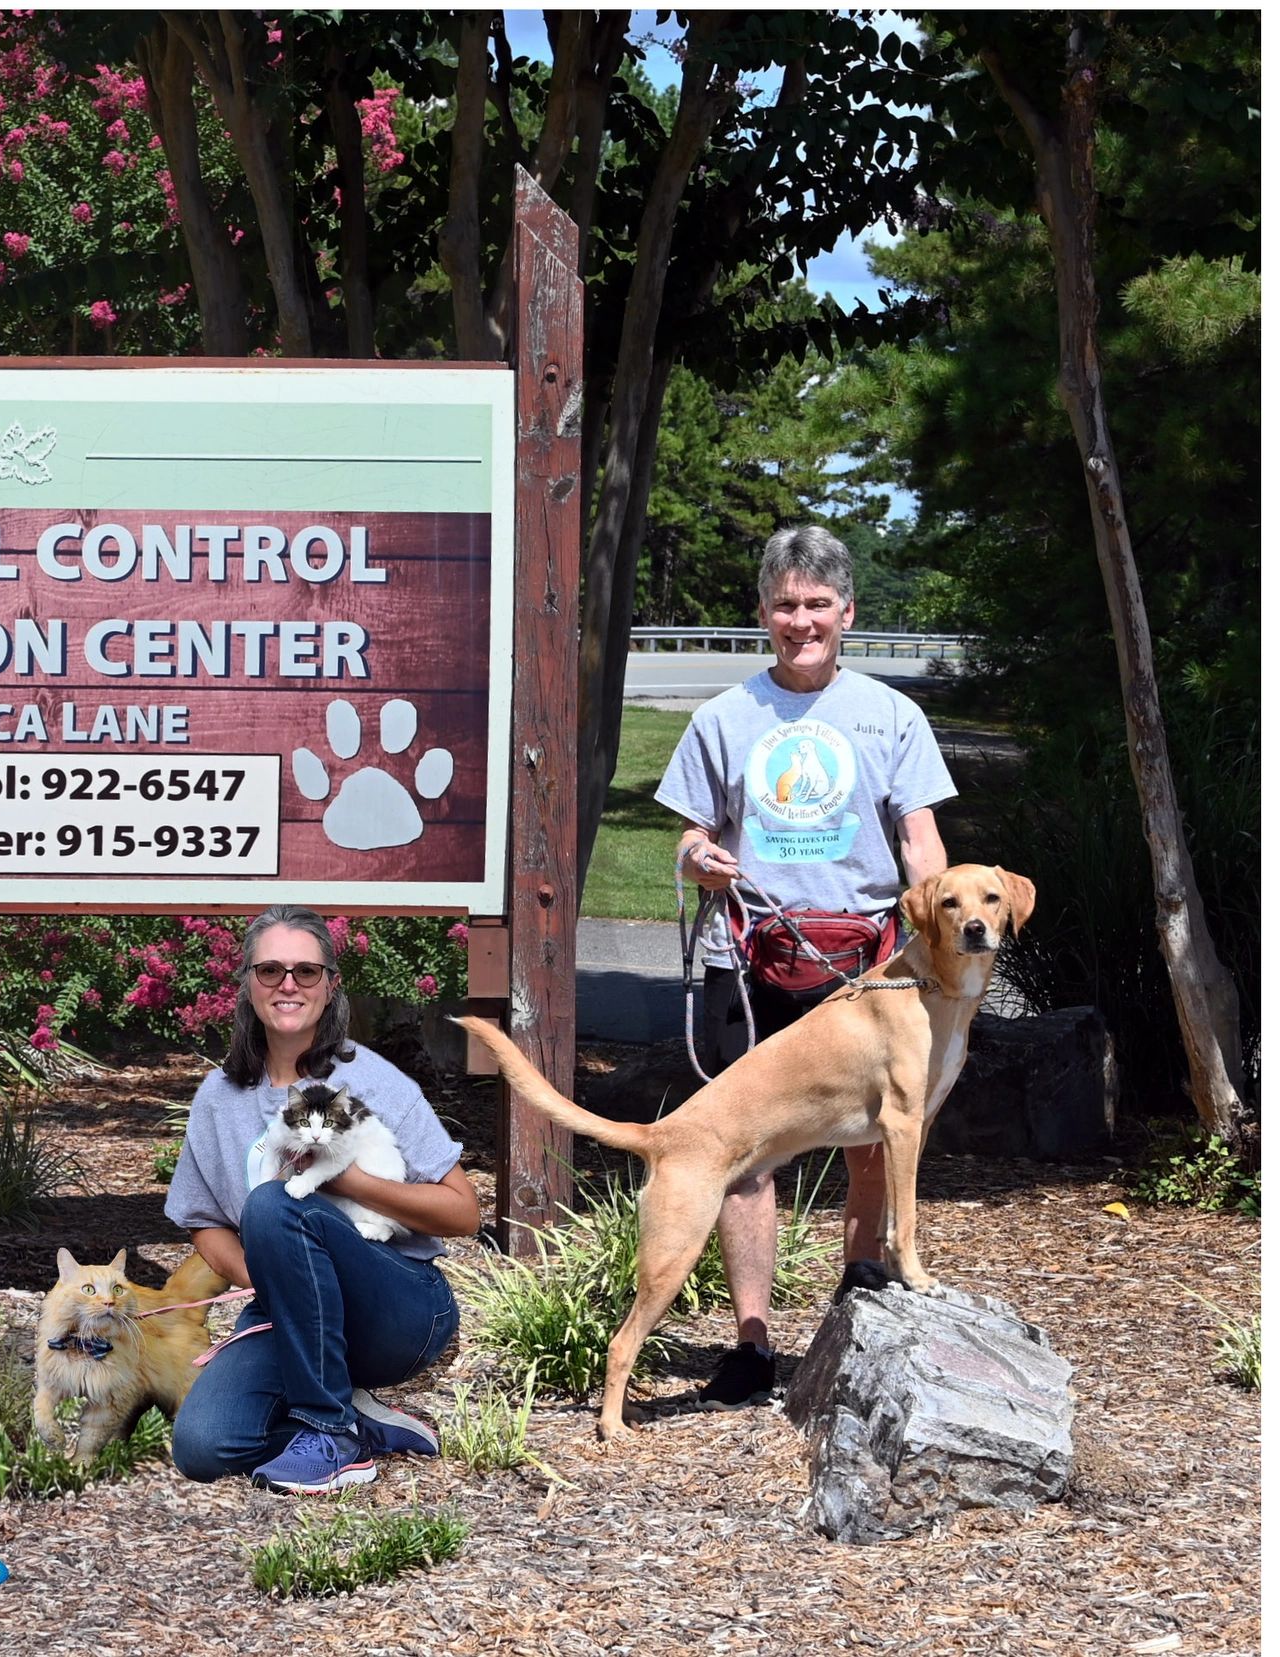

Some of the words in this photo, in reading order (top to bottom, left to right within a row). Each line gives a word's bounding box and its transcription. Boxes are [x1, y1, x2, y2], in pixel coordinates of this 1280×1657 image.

[35, 521, 389, 585] CONTROL
[83, 619, 370, 680] CENTER
[62, 702, 192, 744] LANE
[853, 722, 885, 737] Julie
[41, 768, 246, 802] 922-6547
[760, 792, 787, 816] Animal
[788, 808, 819, 820] Welfare
[819, 790, 845, 815] League
[56, 824, 260, 858] 915-9337
[765, 835, 796, 844] SAVING
[797, 836, 821, 844] LIVES
[822, 834, 840, 843] FOR
[779, 846, 796, 859] 30
[799, 847, 825, 856] YEARS
